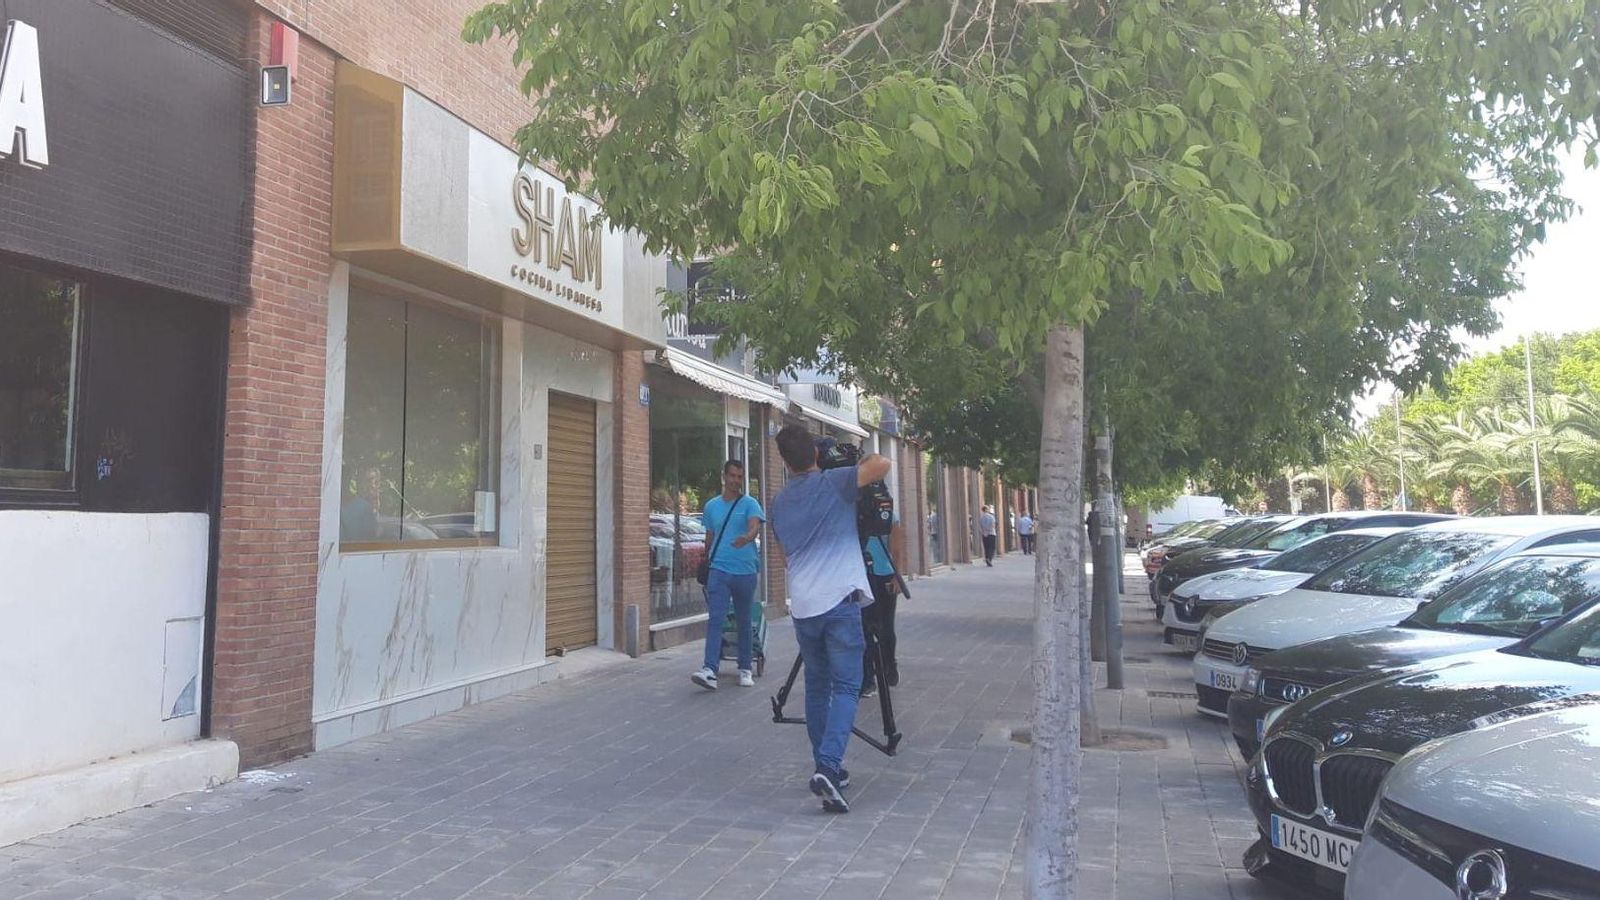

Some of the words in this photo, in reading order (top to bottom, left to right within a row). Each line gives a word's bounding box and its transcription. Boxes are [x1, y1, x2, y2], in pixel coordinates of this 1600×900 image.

[0, 19, 49, 167] A
[511, 171, 603, 291] SHAM
[510, 264, 553, 292] COCINA
[556, 283, 603, 312] LIBANESA
[1282, 823, 1320, 858] 1450
